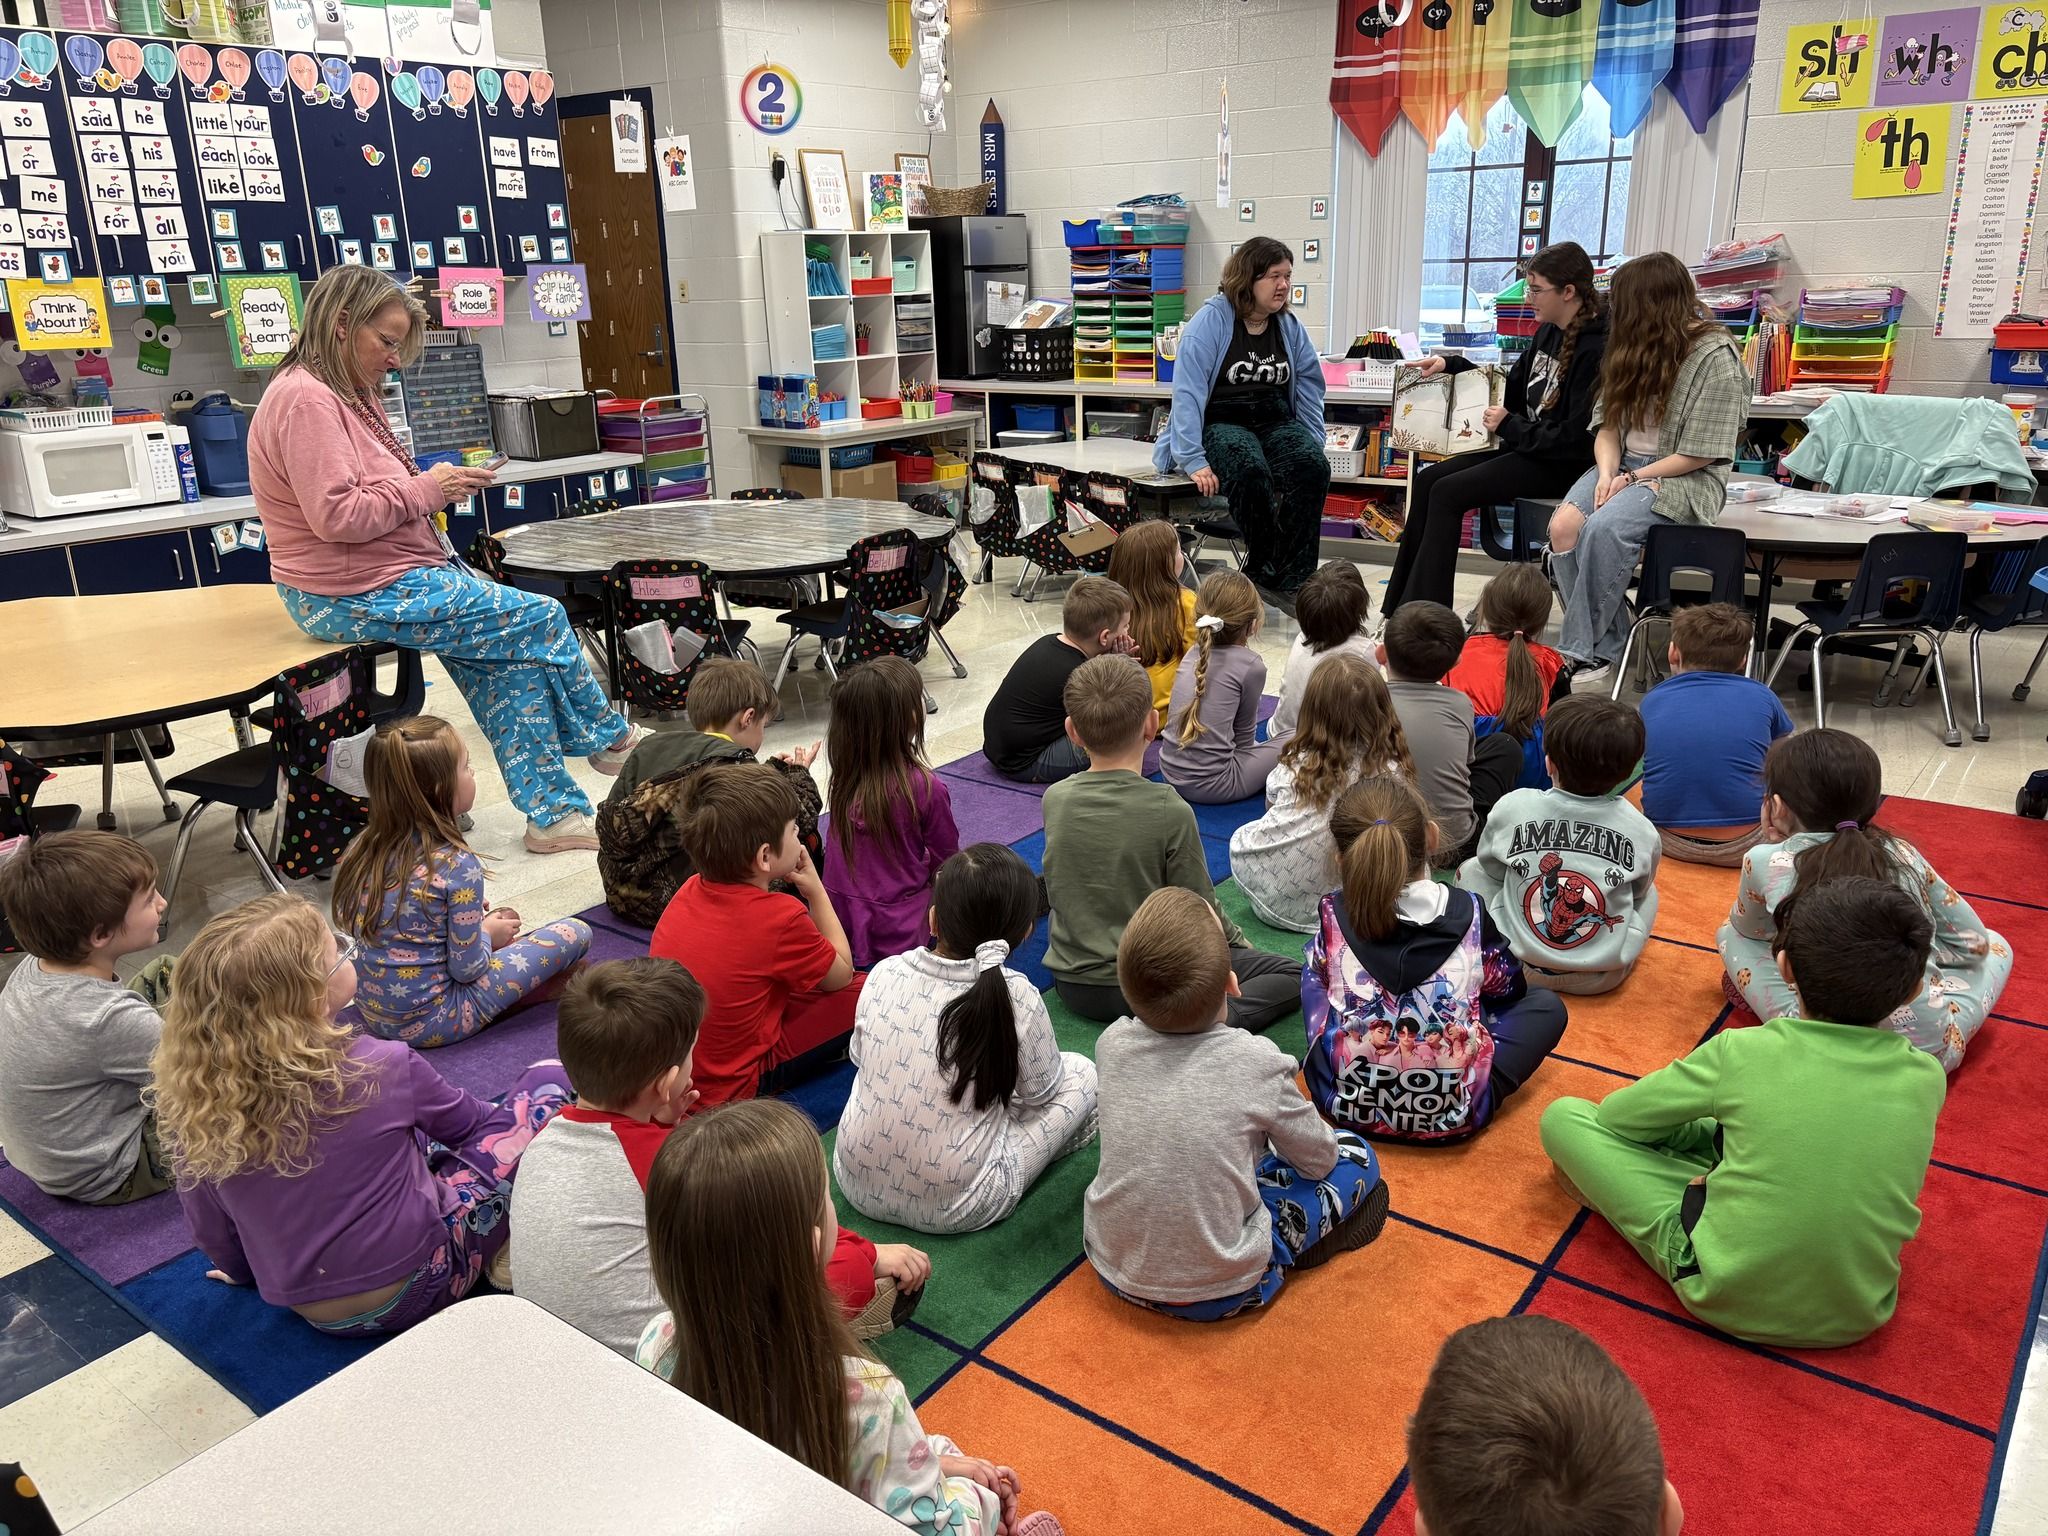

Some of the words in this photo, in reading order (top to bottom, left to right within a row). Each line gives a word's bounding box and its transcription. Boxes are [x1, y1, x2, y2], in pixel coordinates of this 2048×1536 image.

[1895, 33, 1954, 75] wh
[1993, 31, 2048, 79] ch
[758, 72, 785, 113] 2
[14, 116, 32, 127] so
[81, 113, 112, 127] said
[135, 112, 154, 125] he
[195, 116, 228, 130] little
[234, 119, 268, 133] your
[984, 133, 996, 165] MRS.
[1880, 118, 1930, 168] th
[91, 150, 119, 163] are
[142, 147, 163, 161] his
[201, 149, 236, 163] each
[243, 152, 275, 166] look
[493, 147, 516, 158] have
[531, 147, 556, 159] from
[22, 158, 39, 169] or
[96, 184, 125, 199] her
[142, 184, 175, 203] they
[207, 178, 240, 195] like
[248, 182, 281, 198] good
[499, 182, 524, 192] more
[32, 189, 58, 203] me
[1314, 202, 1324, 213] 10
[0, 222, 13, 233] o
[103, 213, 130, 228] for
[156, 218, 177, 235] all
[27, 228, 66, 242] says
[1974, 241, 2002, 249] Kingston
[158, 253, 188, 268] you
[462, 288, 483, 298] Role
[41, 303, 77, 314] Think
[242, 301, 285, 315] Ready
[459, 300, 488, 310] Model
[36, 317, 76, 328] About
[80, 317, 89, 328] It
[260, 317, 273, 327] to
[249, 332, 290, 344] Learn
[141, 363, 164, 375] Green
[32, 378, 56, 391] Purple
[632, 580, 661, 596] Chloe
[1507, 820, 1635, 872] AMAZING
[1893, 1014, 1918, 1025] MILK
[1336, 1079, 1465, 1114] DEMON
[1331, 1096, 1467, 1132] HUNTERS
